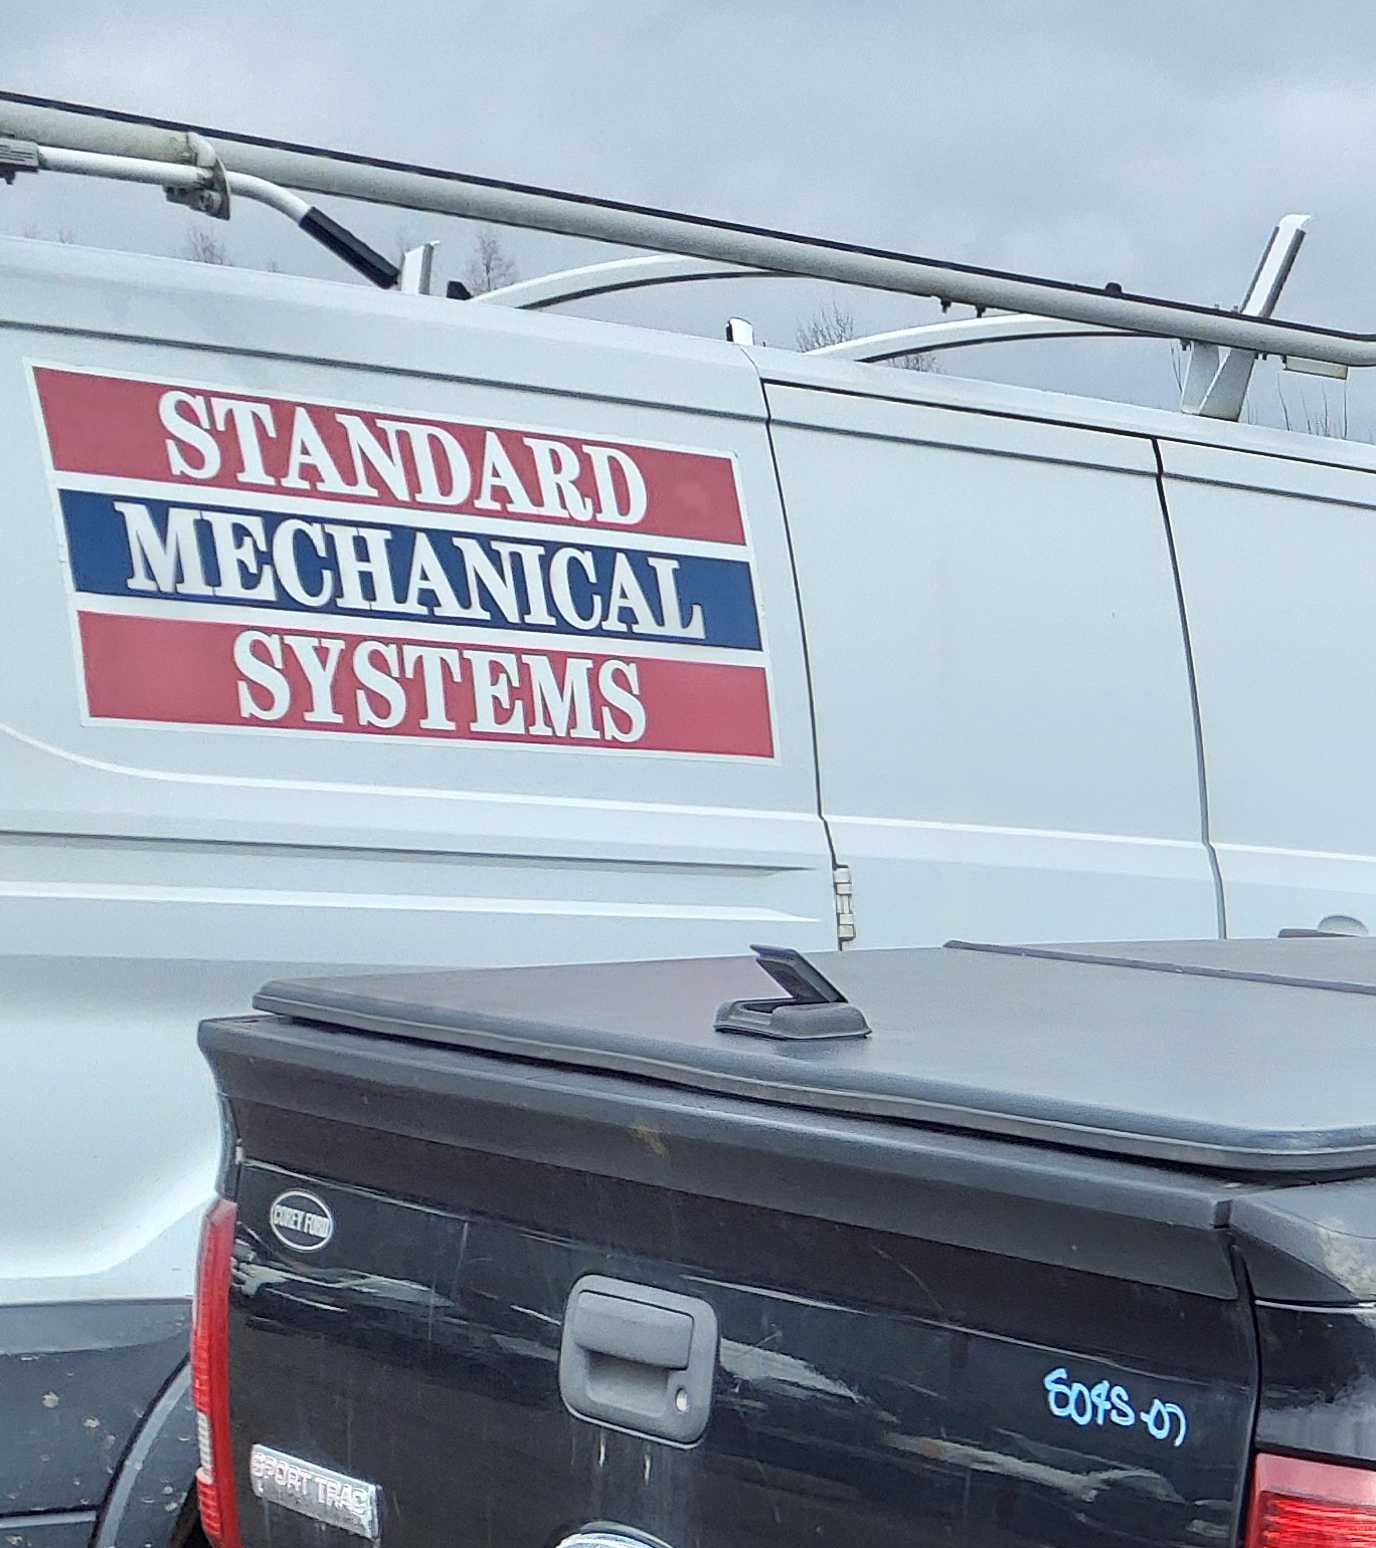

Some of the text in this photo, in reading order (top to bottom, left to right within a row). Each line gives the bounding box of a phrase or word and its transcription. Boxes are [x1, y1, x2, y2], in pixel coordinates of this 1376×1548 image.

[158, 389, 648, 526] STANDARD
[114, 500, 706, 640] MECHANICAL
[231, 628, 647, 745] SYSTEMS
